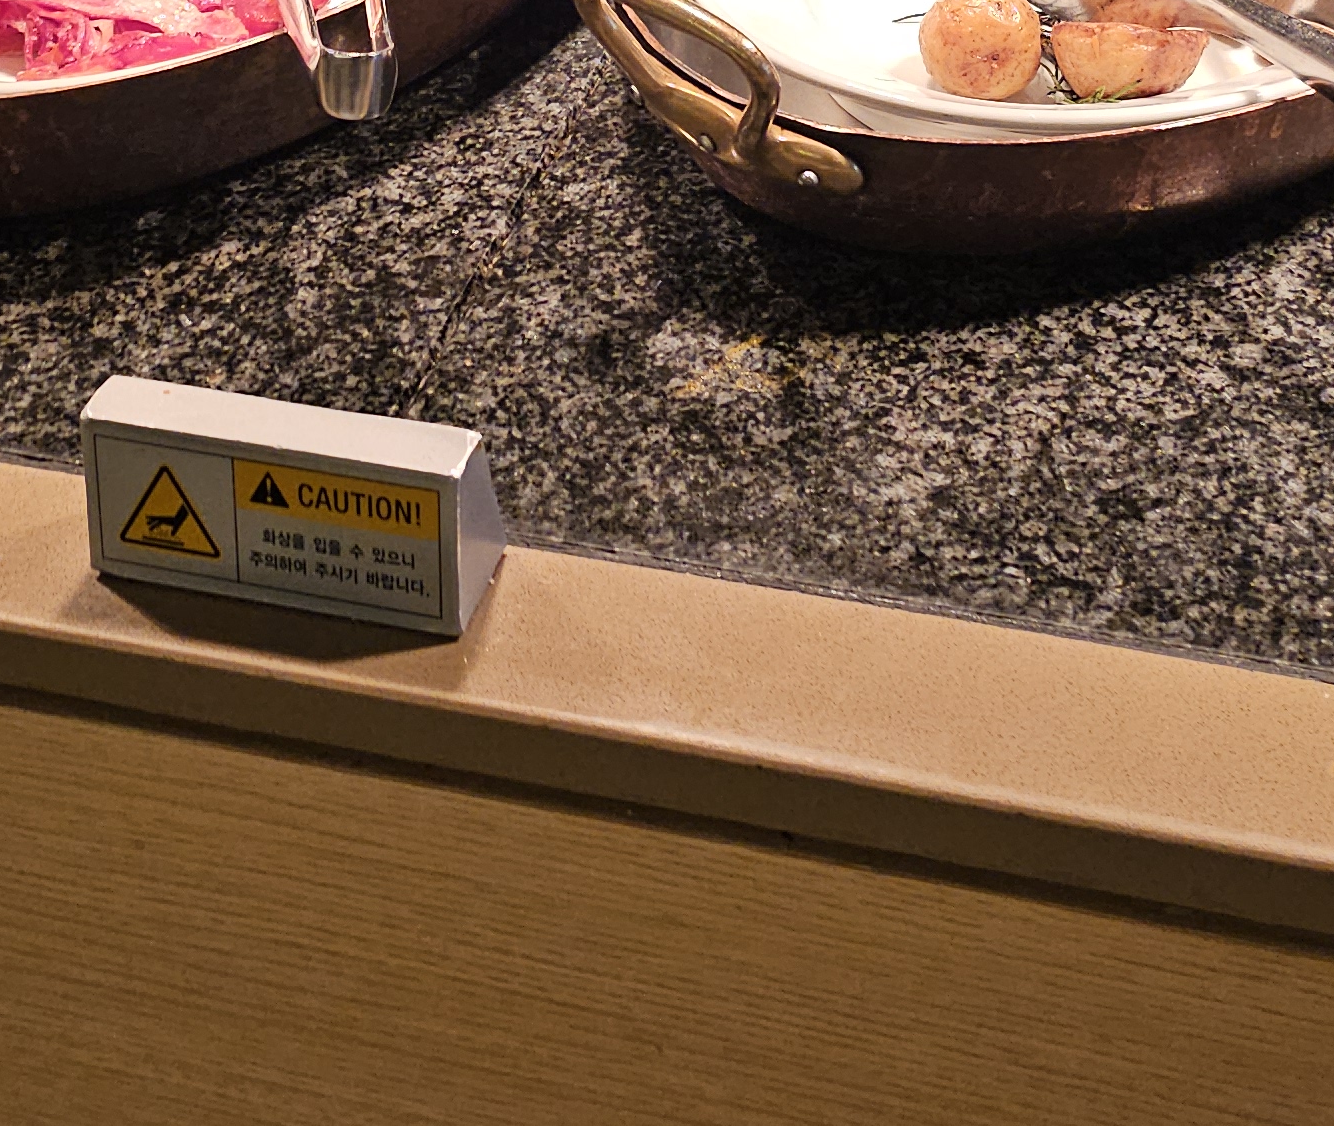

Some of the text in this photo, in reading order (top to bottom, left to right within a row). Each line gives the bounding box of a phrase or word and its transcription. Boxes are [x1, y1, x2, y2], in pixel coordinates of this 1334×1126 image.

[297, 482, 422, 526] CAUTION!
[262, 527, 416, 570] 화상을 입을 수 있으니
[248, 549, 431, 598] 주의하여 주시기 바랍니다.
